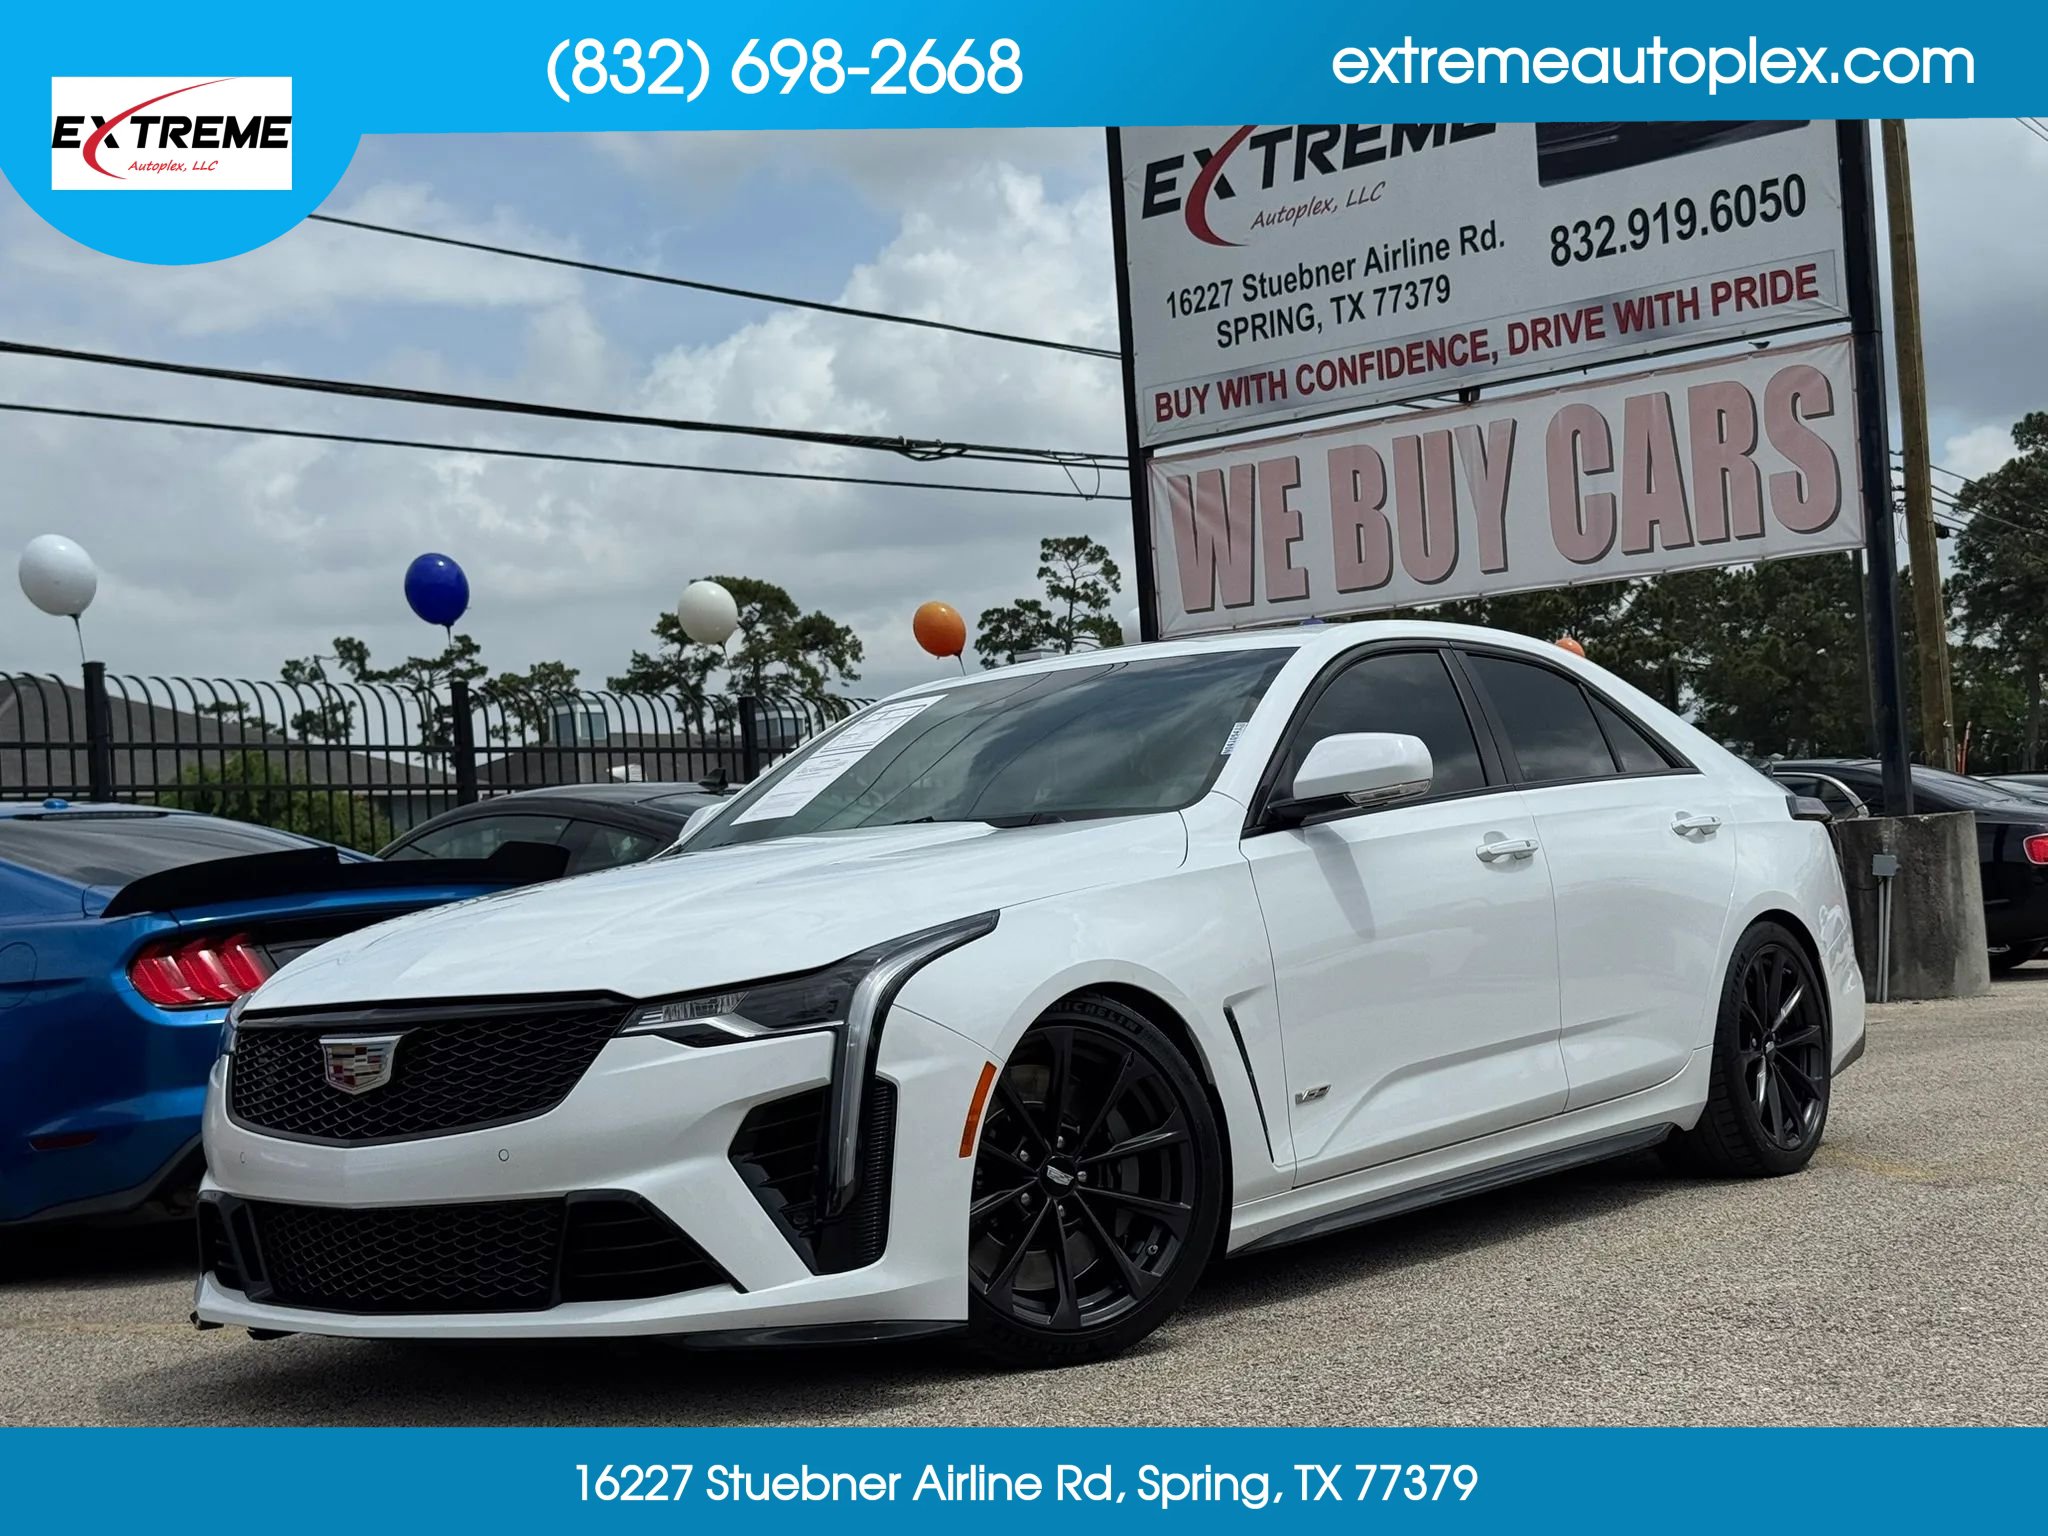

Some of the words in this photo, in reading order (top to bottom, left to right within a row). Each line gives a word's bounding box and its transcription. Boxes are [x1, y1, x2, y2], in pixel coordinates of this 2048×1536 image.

[1251, 196, 1338, 230] Autoplex,
[1346, 181, 1386, 208] LLC
[1550, 174, 1806, 267] 832.919.6050
[1166, 279, 1234, 319] 16227
[1242, 257, 1356, 303] Stuebner
[1363, 237, 1450, 277] Airline
[1459, 220, 1505, 256] Rd.
[1217, 302, 1323, 348] SPRING,
[1330, 291, 1366, 324] TX
[1373, 274, 1451, 316] 77379
[1155, 383, 1210, 422] BUY
[1217, 368, 1287, 410] WITH
[1296, 329, 1499, 396] CONFIDENCE,
[1507, 305, 1606, 356] DRIVE
[1613, 286, 1700, 334] WITH
[1710, 263, 1819, 316] PRIDE
[1167, 455, 1309, 614] WE
[1327, 418, 1516, 594] BUY
[1545, 364, 1842, 565] CARS
